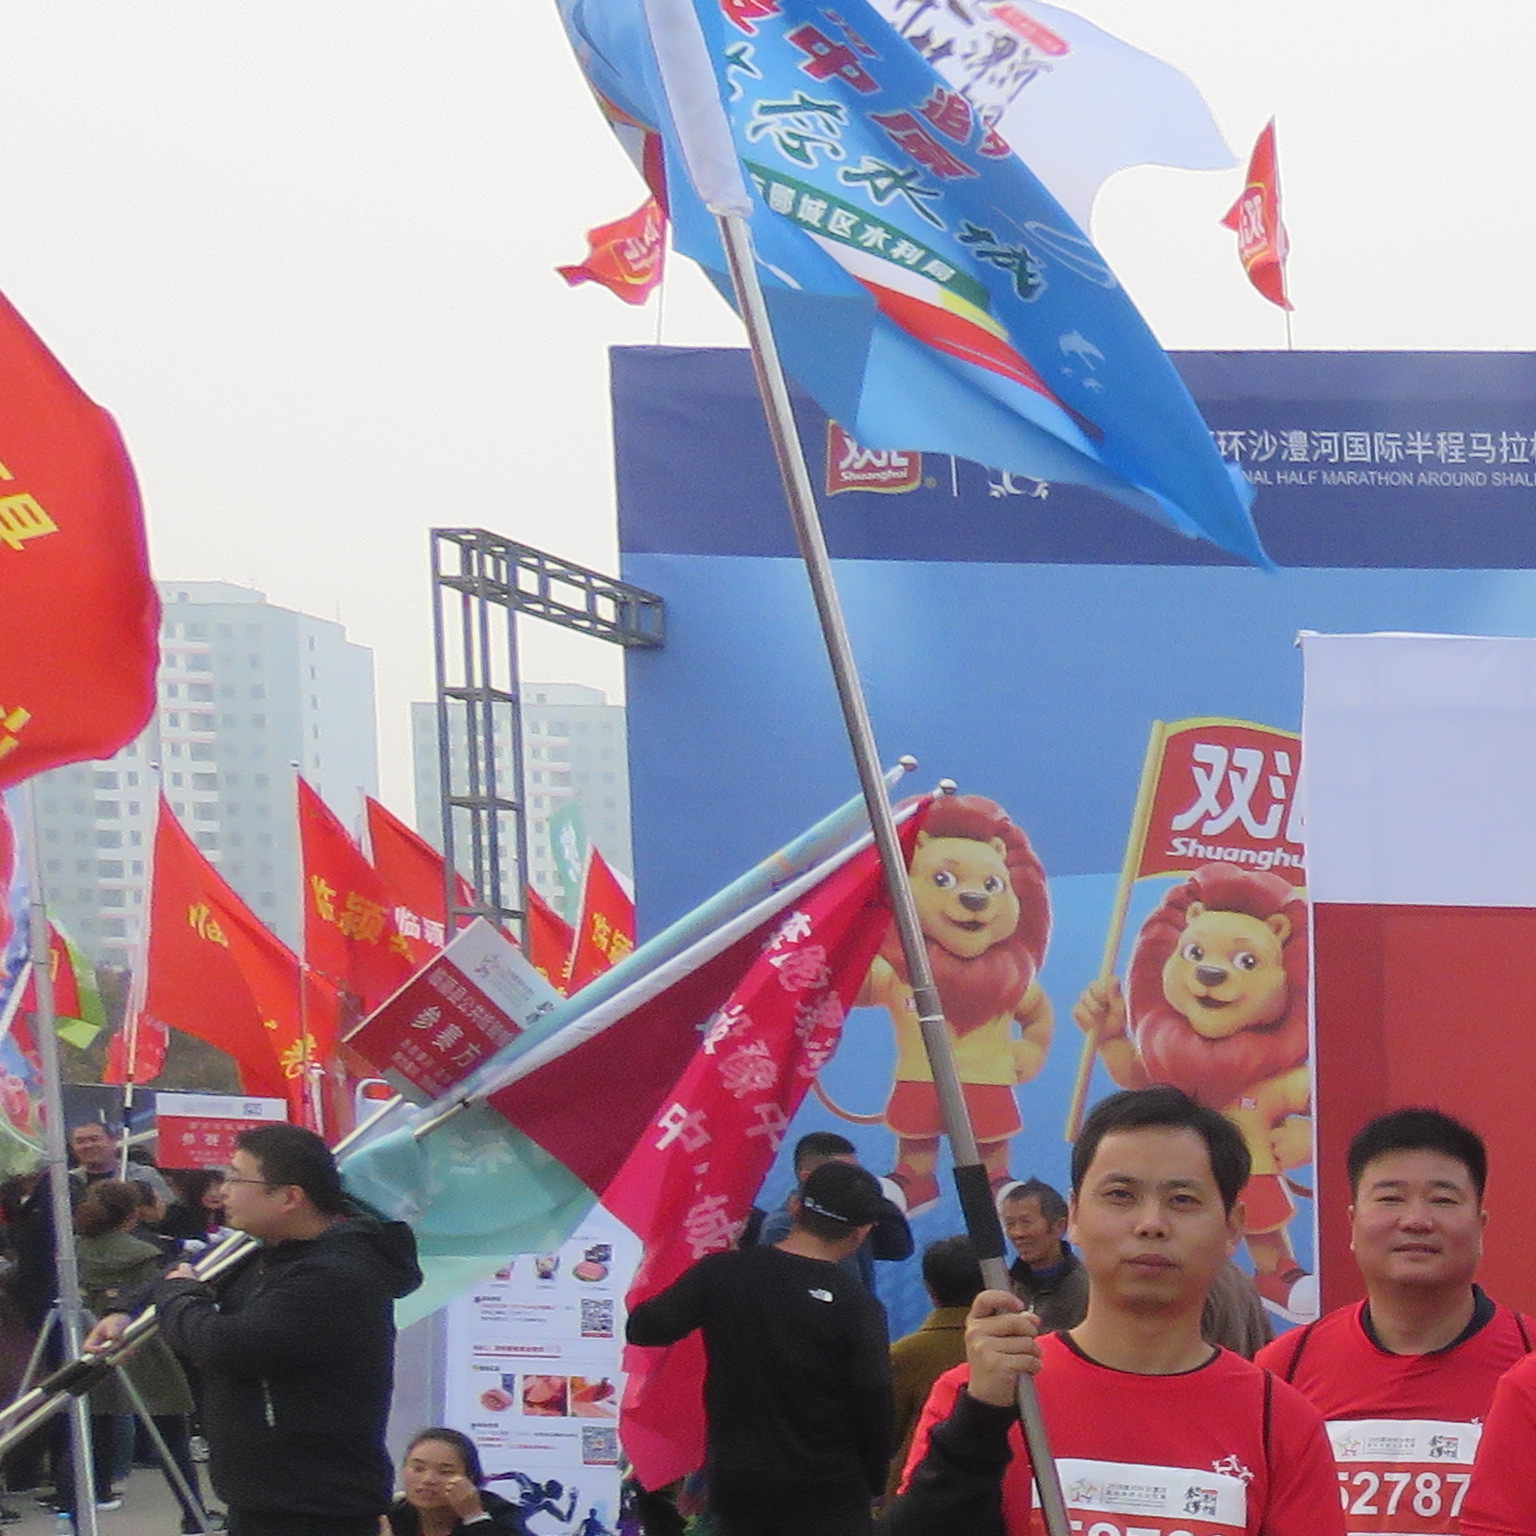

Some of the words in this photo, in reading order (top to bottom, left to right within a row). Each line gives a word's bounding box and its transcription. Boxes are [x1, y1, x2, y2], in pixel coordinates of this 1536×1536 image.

[1278, 471, 1324, 486] HALF
[1324, 472, 1414, 487] MARATHON
[1417, 472, 1487, 488] AROUND
